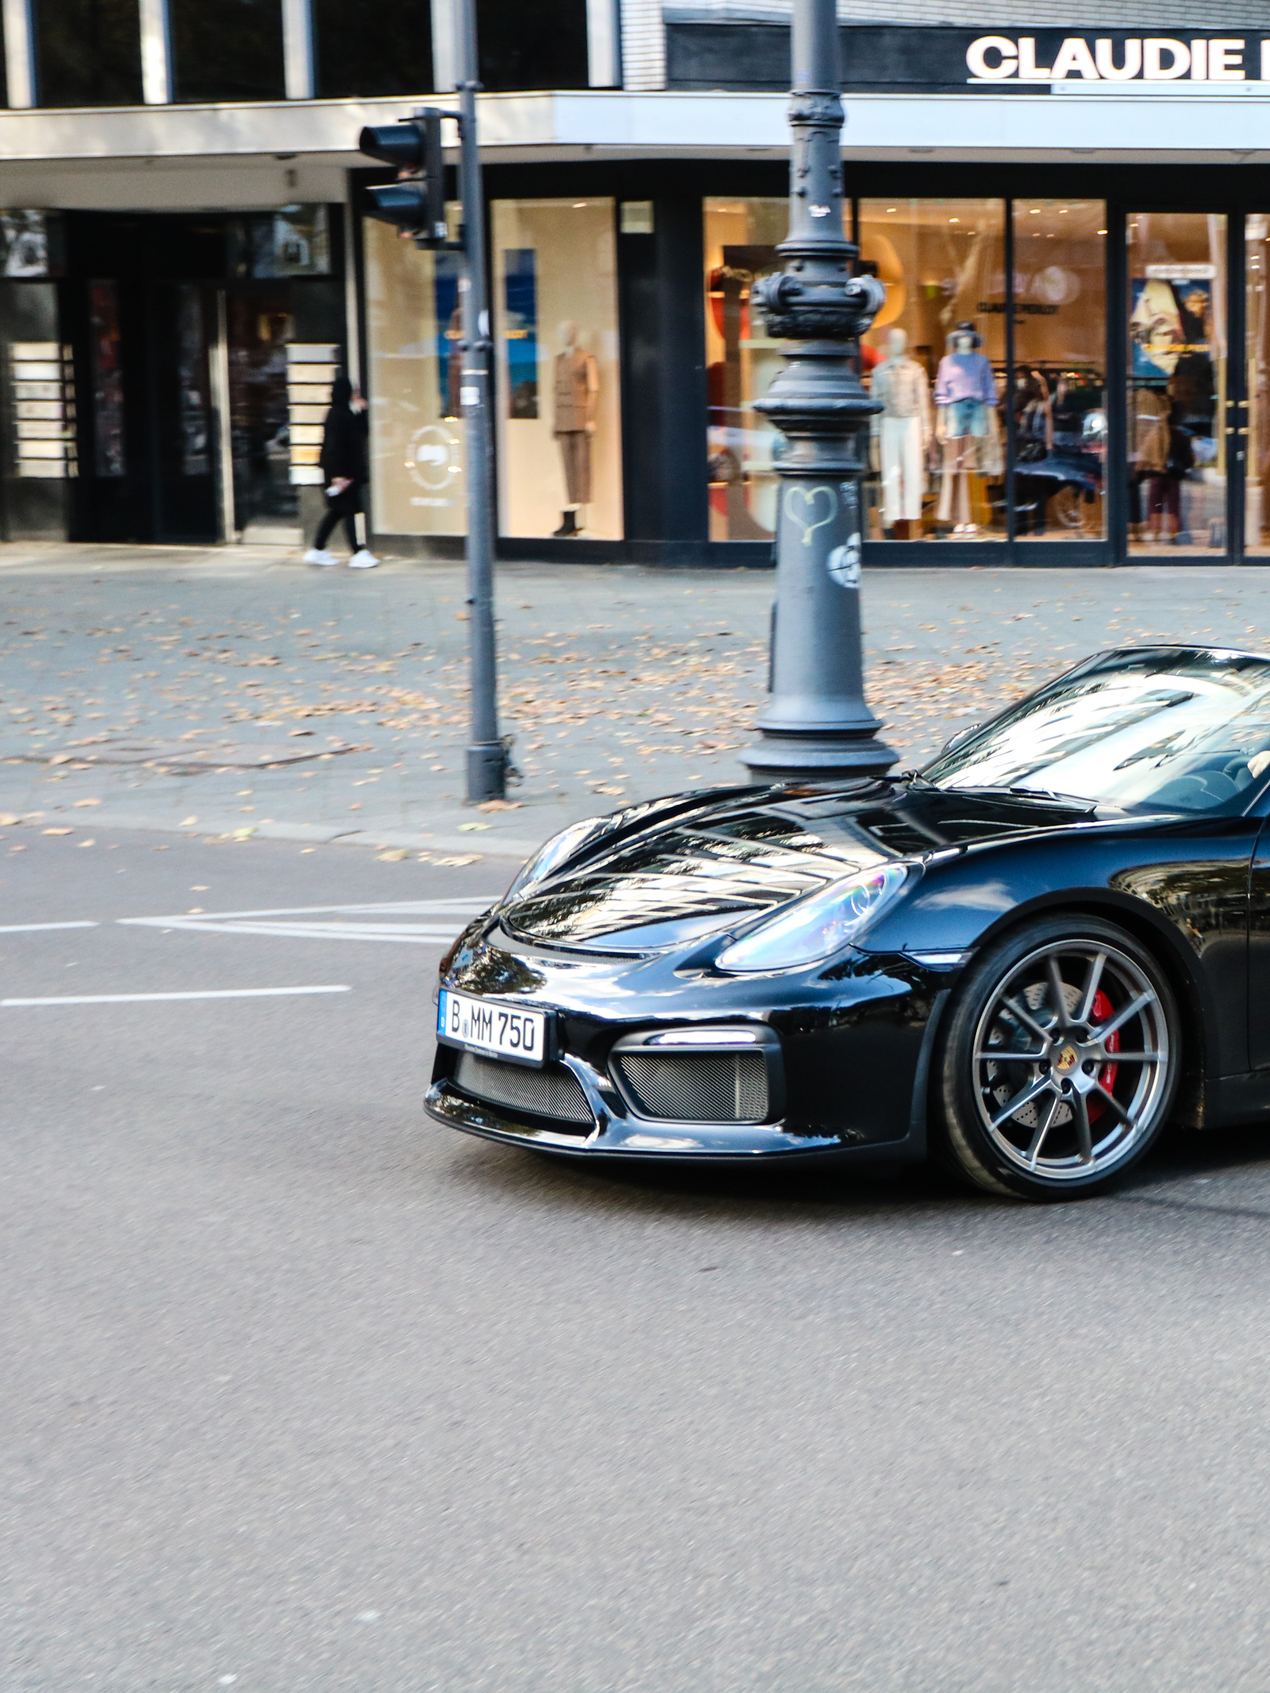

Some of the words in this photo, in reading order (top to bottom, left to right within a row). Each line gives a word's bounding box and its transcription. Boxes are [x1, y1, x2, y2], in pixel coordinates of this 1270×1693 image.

[966, 36, 1246, 80] CLAUDIE
[451, 999, 460, 1033] B
[470, 1005, 493, 1043] MM
[498, 1011, 535, 1051] 750
